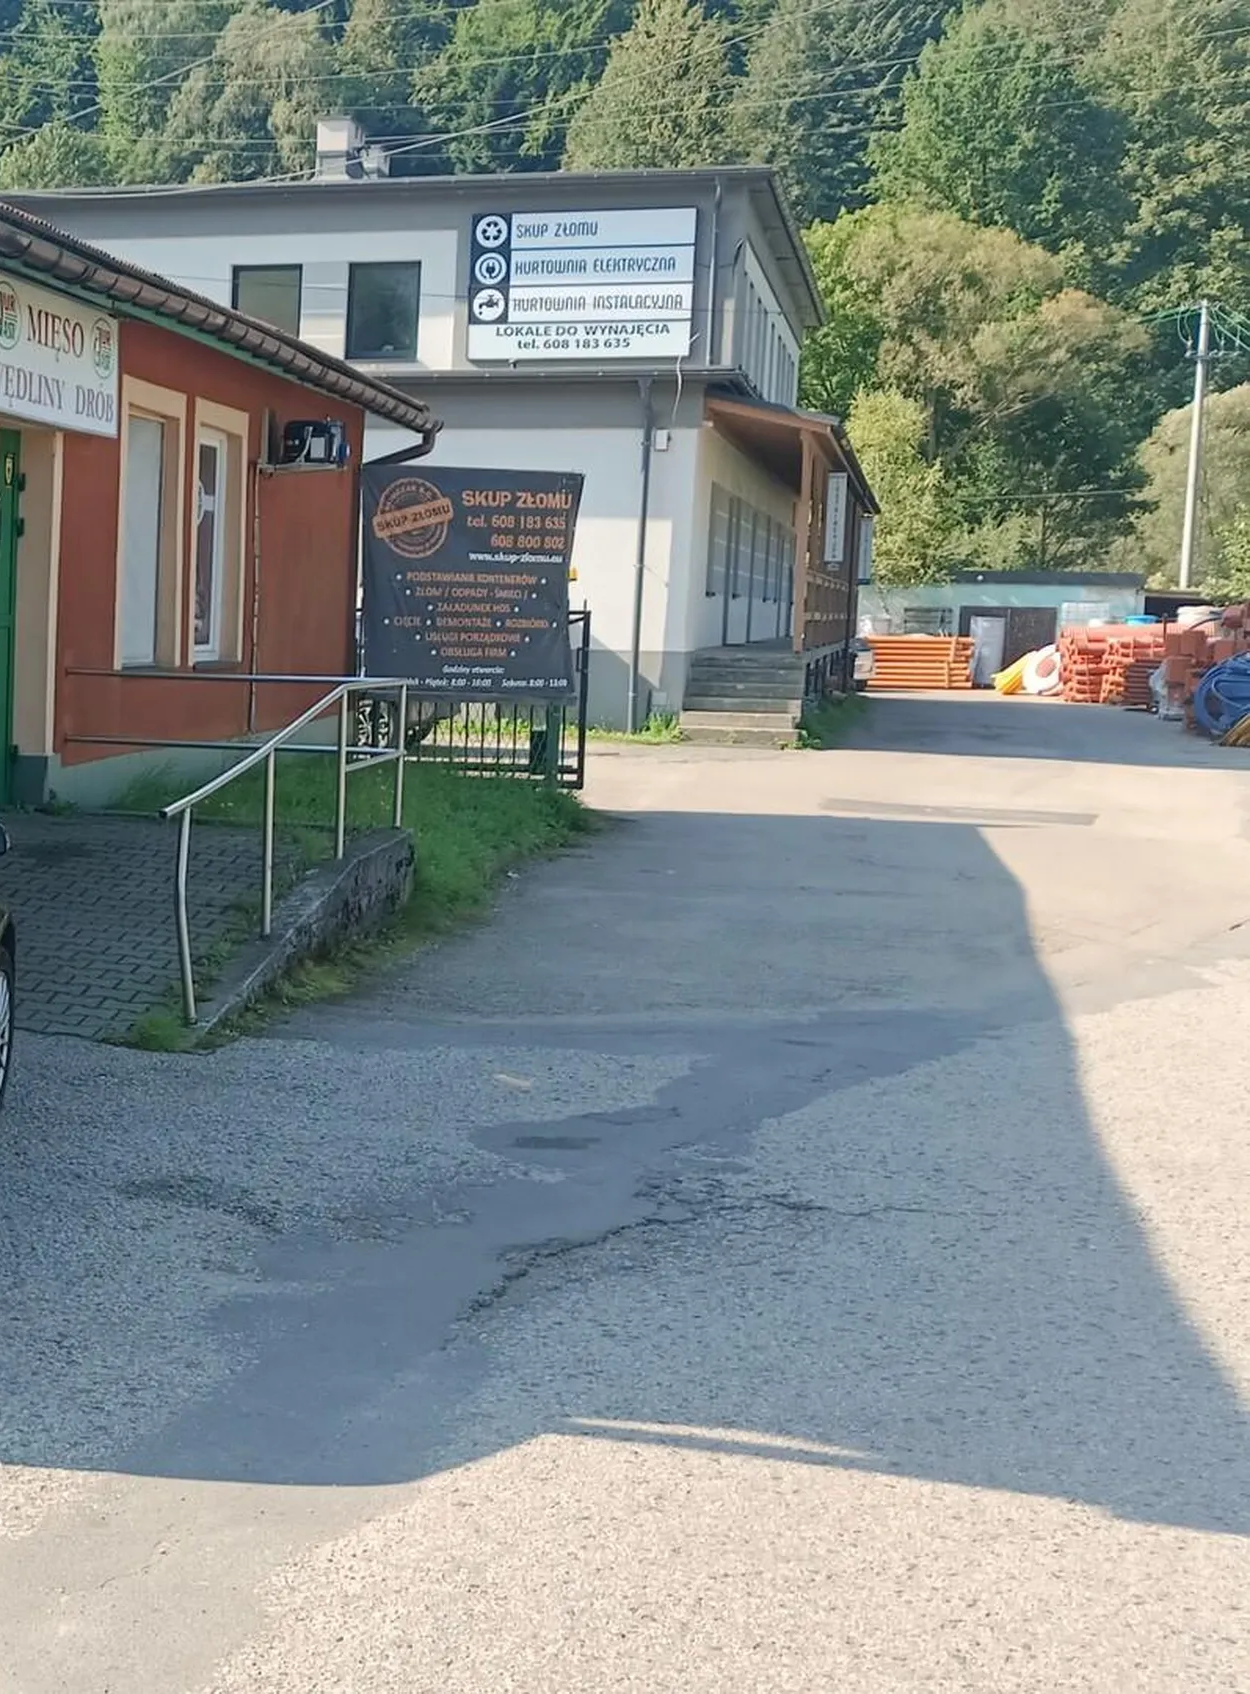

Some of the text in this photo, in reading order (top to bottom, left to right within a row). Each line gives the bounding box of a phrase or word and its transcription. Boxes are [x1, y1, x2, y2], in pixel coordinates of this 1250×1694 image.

[516, 221, 598, 239] SKUP ZŁOMU
[515, 256, 676, 276] HURTOWNIA ELEKTRYCZNA
[513, 294, 683, 312] HURTOWNIA INSTALACYJNA
[27, 304, 85, 363] MIĘSO
[496, 323, 671, 337] LOKALE DO WYNAJĘCIA
[518, 337, 631, 350] tel. 608 183 635
[75, 382, 114, 424] DRÓB
[462, 490, 572, 509] SKUP ZŁOMU
[467, 515, 566, 529] tel. 608 183 635
[517, 535, 541, 549] 800
